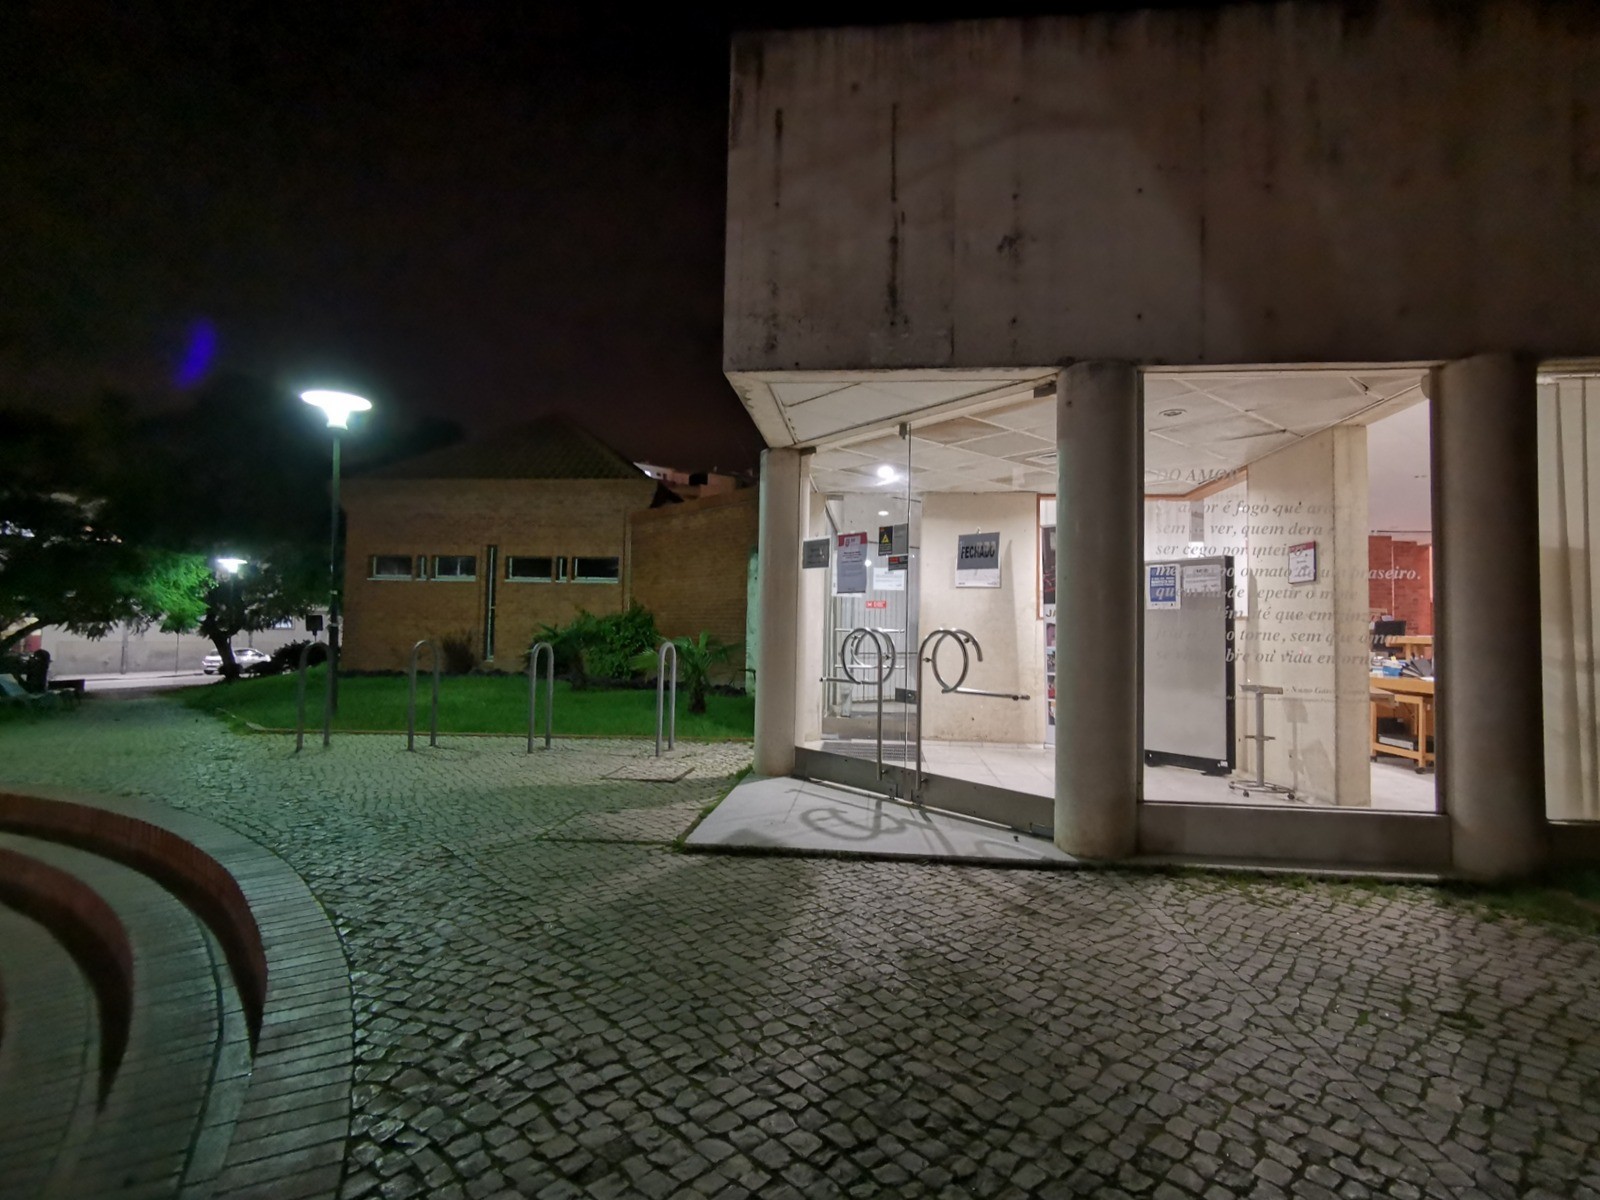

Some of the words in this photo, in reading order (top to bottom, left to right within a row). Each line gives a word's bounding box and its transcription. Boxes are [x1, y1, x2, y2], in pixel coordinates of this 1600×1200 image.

[1223, 500, 1233, 514] é
[1233, 500, 1269, 517] fogo
[1156, 524, 1186, 535] sem
[1210, 524, 1237, 537] ver,
[1241, 525, 1284, 539] quem
[1288, 522, 1323, 536] dera
[1155, 544, 1179, 556] ser
[1252, 543, 1308, 558] inteio.
[1250, 588, 1302, 603] epetir
[1275, 610, 1304, 624] que
[1240, 630, 1287, 644] torne,
[1290, 632, 1321, 643] sem
[1281, 650, 1313, 665] vida
